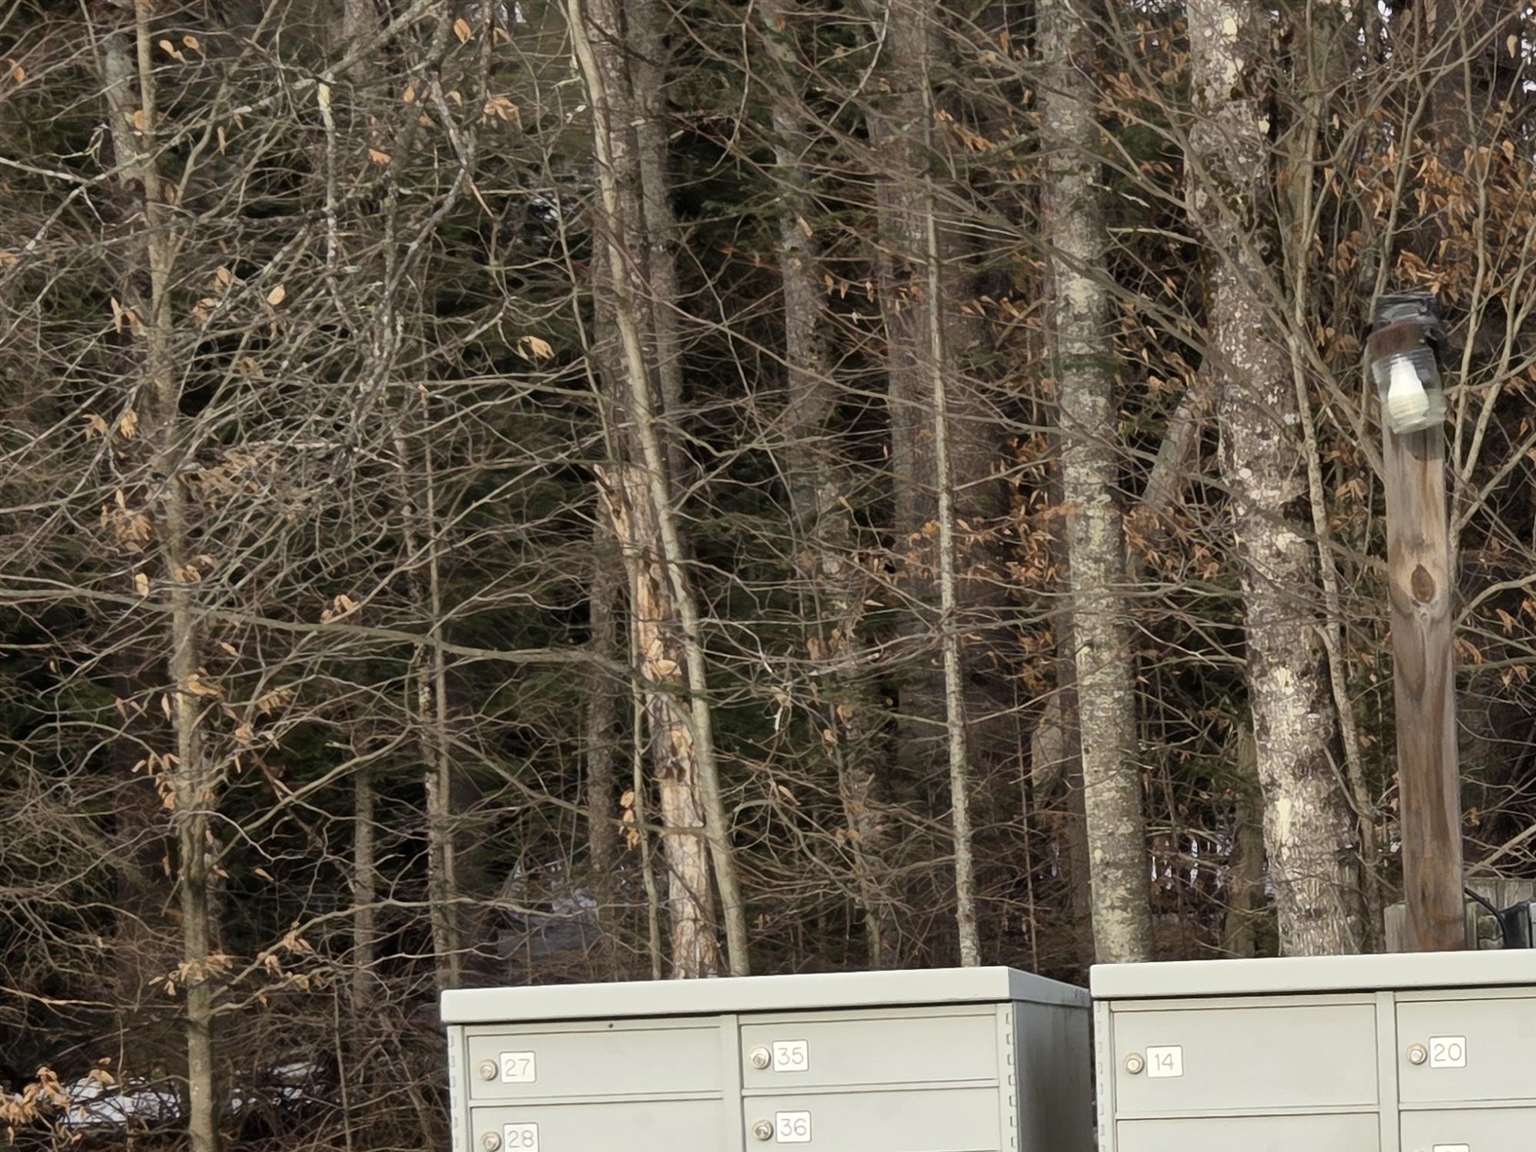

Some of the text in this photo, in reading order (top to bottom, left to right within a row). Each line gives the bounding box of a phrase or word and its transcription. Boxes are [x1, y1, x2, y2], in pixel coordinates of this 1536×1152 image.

[777, 1046, 804, 1066] 35
[1154, 1052, 1174, 1071] 14
[1433, 1042, 1463, 1062] 20
[505, 1058, 531, 1078] 27
[780, 1117, 807, 1137] 36
[507, 1129, 534, 1149] 28
